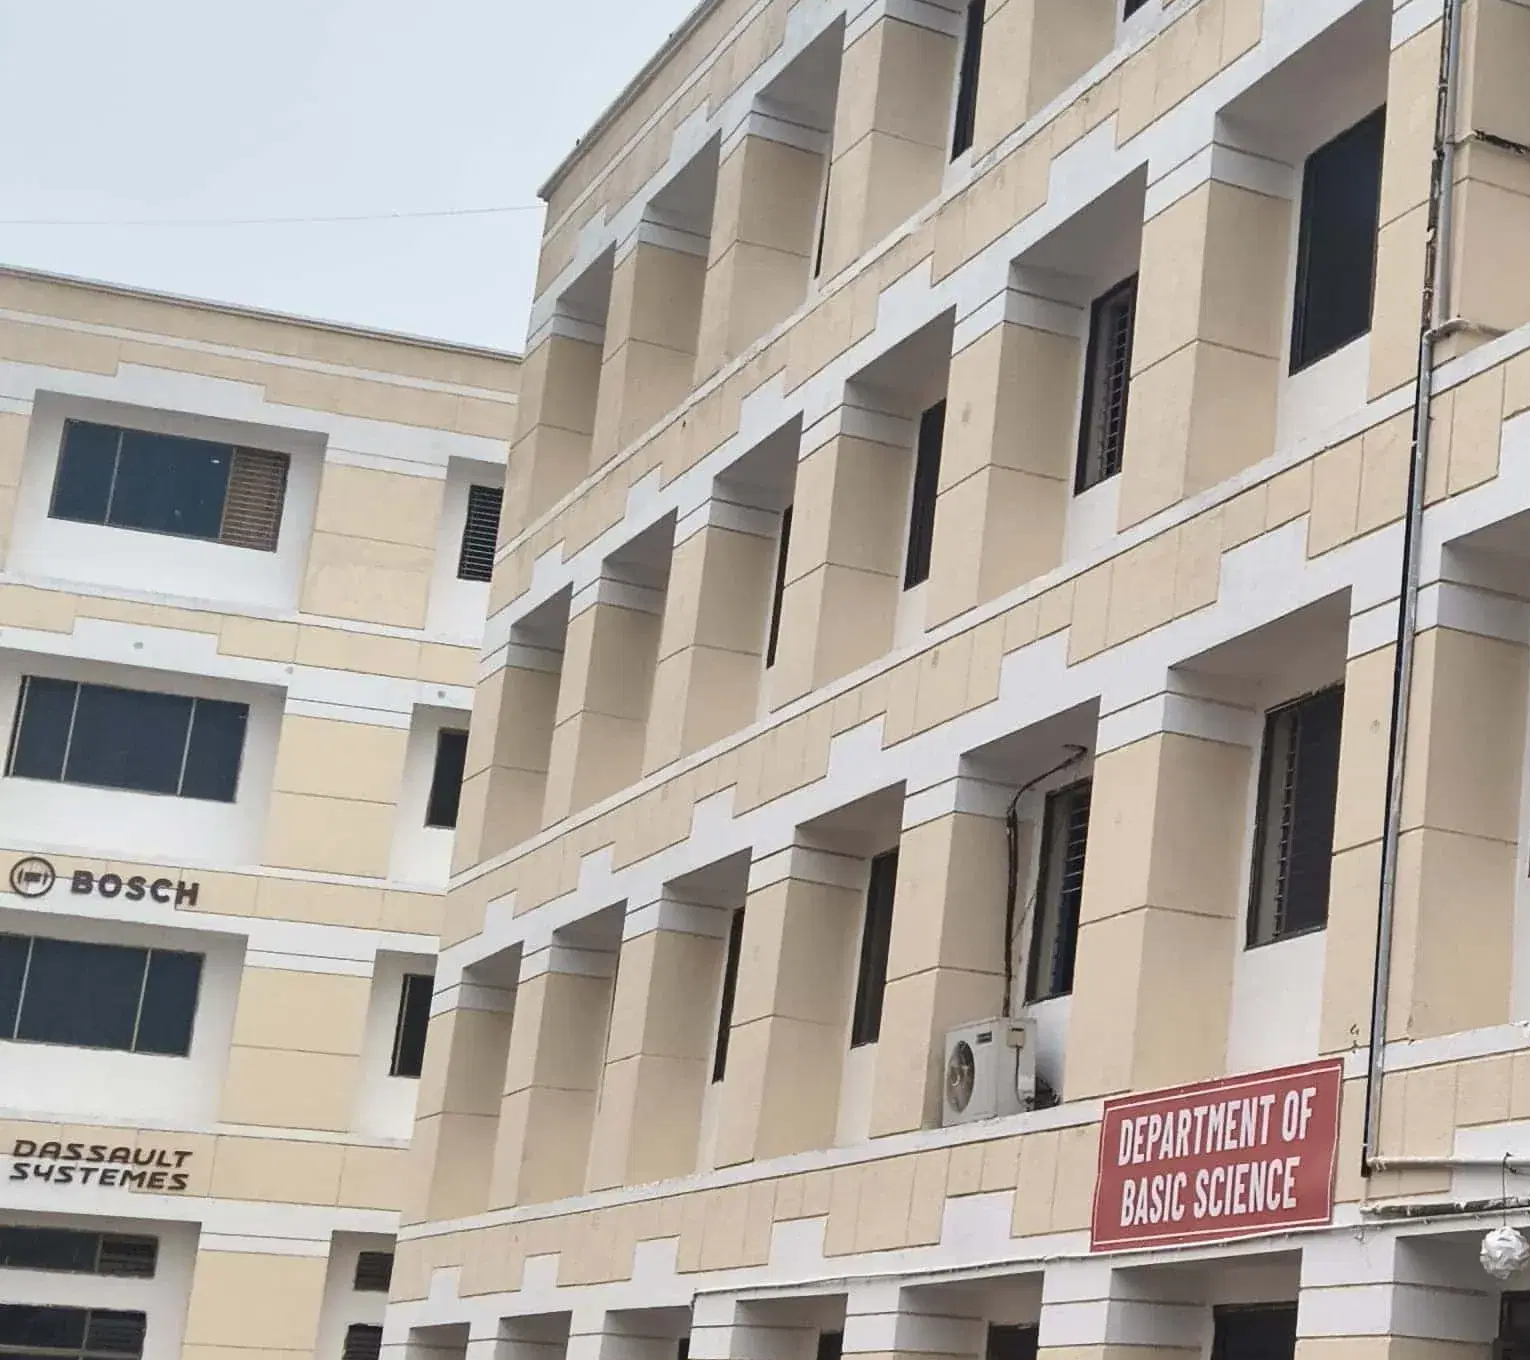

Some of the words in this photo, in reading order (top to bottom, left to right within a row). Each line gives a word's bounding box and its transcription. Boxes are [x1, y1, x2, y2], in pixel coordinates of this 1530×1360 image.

[71, 870, 200, 906] BOSCH
[1118, 1093, 1276, 1167] DEPARTMENT
[1281, 1087, 1317, 1142] OF
[13, 1139, 193, 1169] DASSAULT
[1120, 1171, 1188, 1227] BASIC
[1193, 1156, 1301, 1219] SCIENCE
